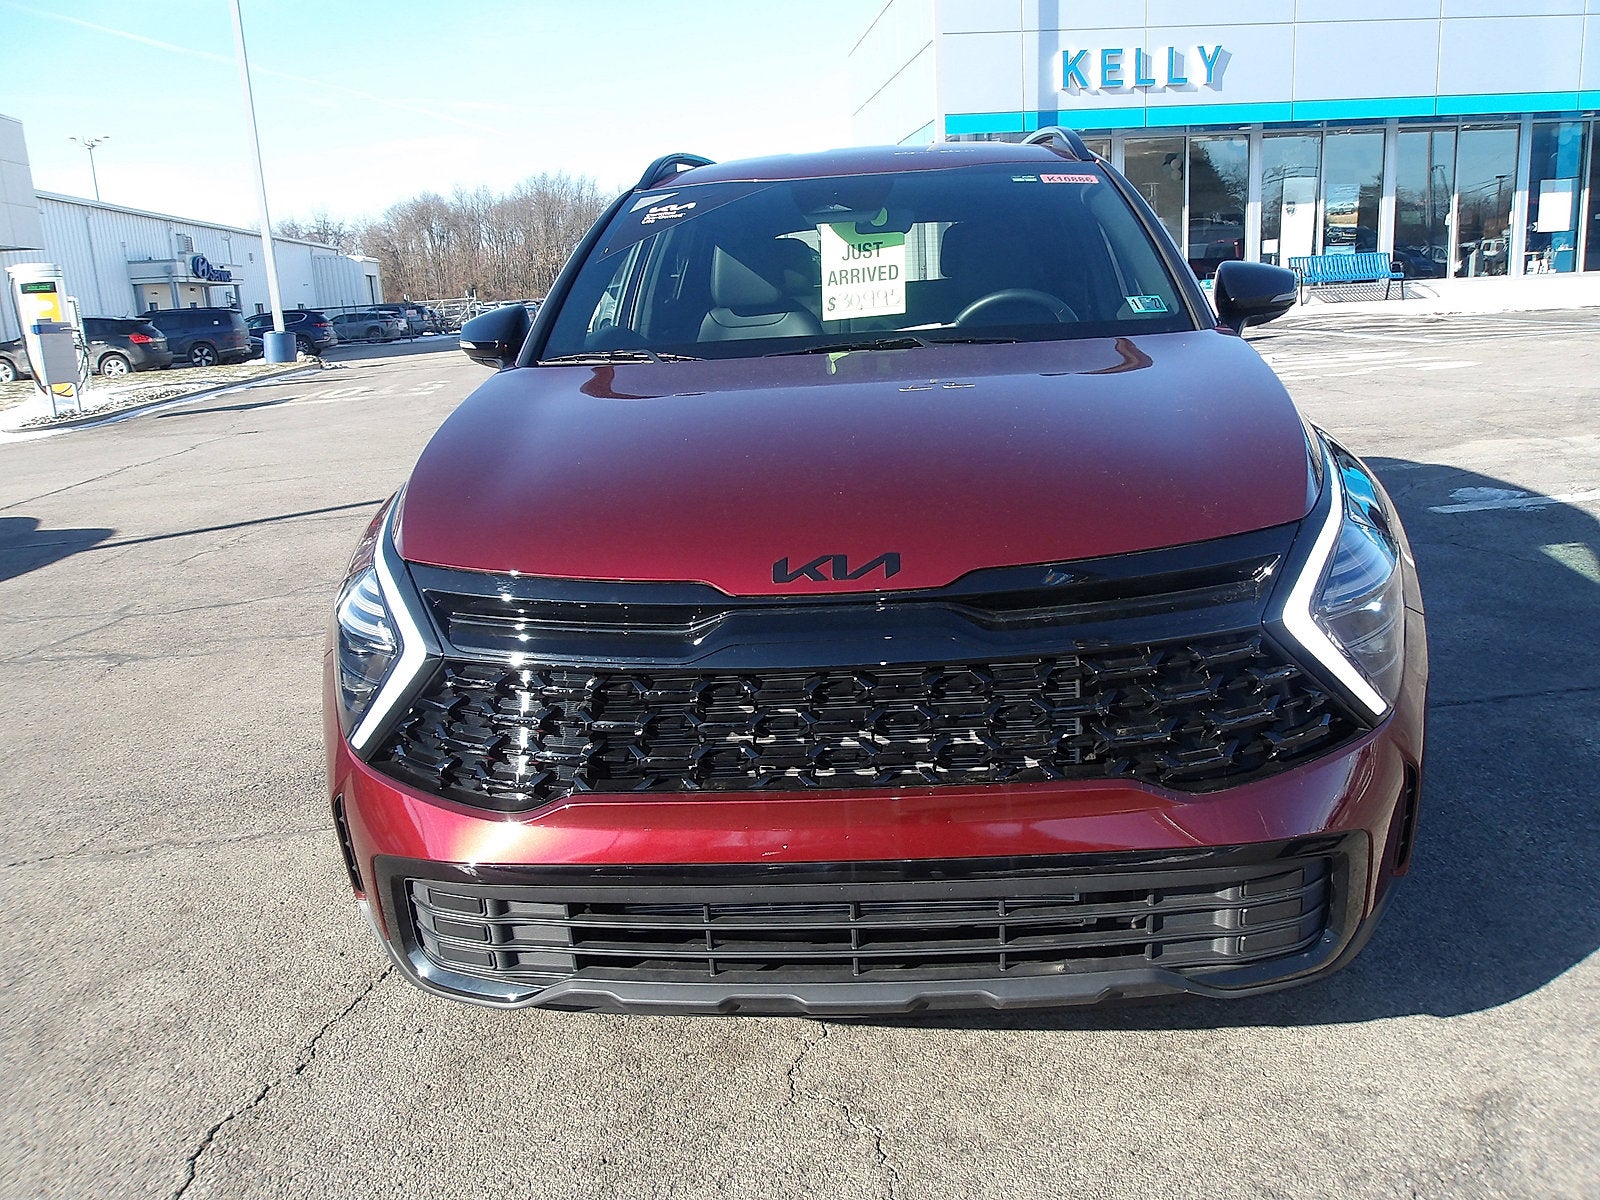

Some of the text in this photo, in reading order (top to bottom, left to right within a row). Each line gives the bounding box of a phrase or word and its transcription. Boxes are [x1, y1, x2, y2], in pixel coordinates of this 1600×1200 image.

[1062, 45, 1223, 89] KELLY
[842, 242, 884, 260] JUST
[827, 265, 900, 286] ARRIVED
[772, 552, 901, 584] KIA
